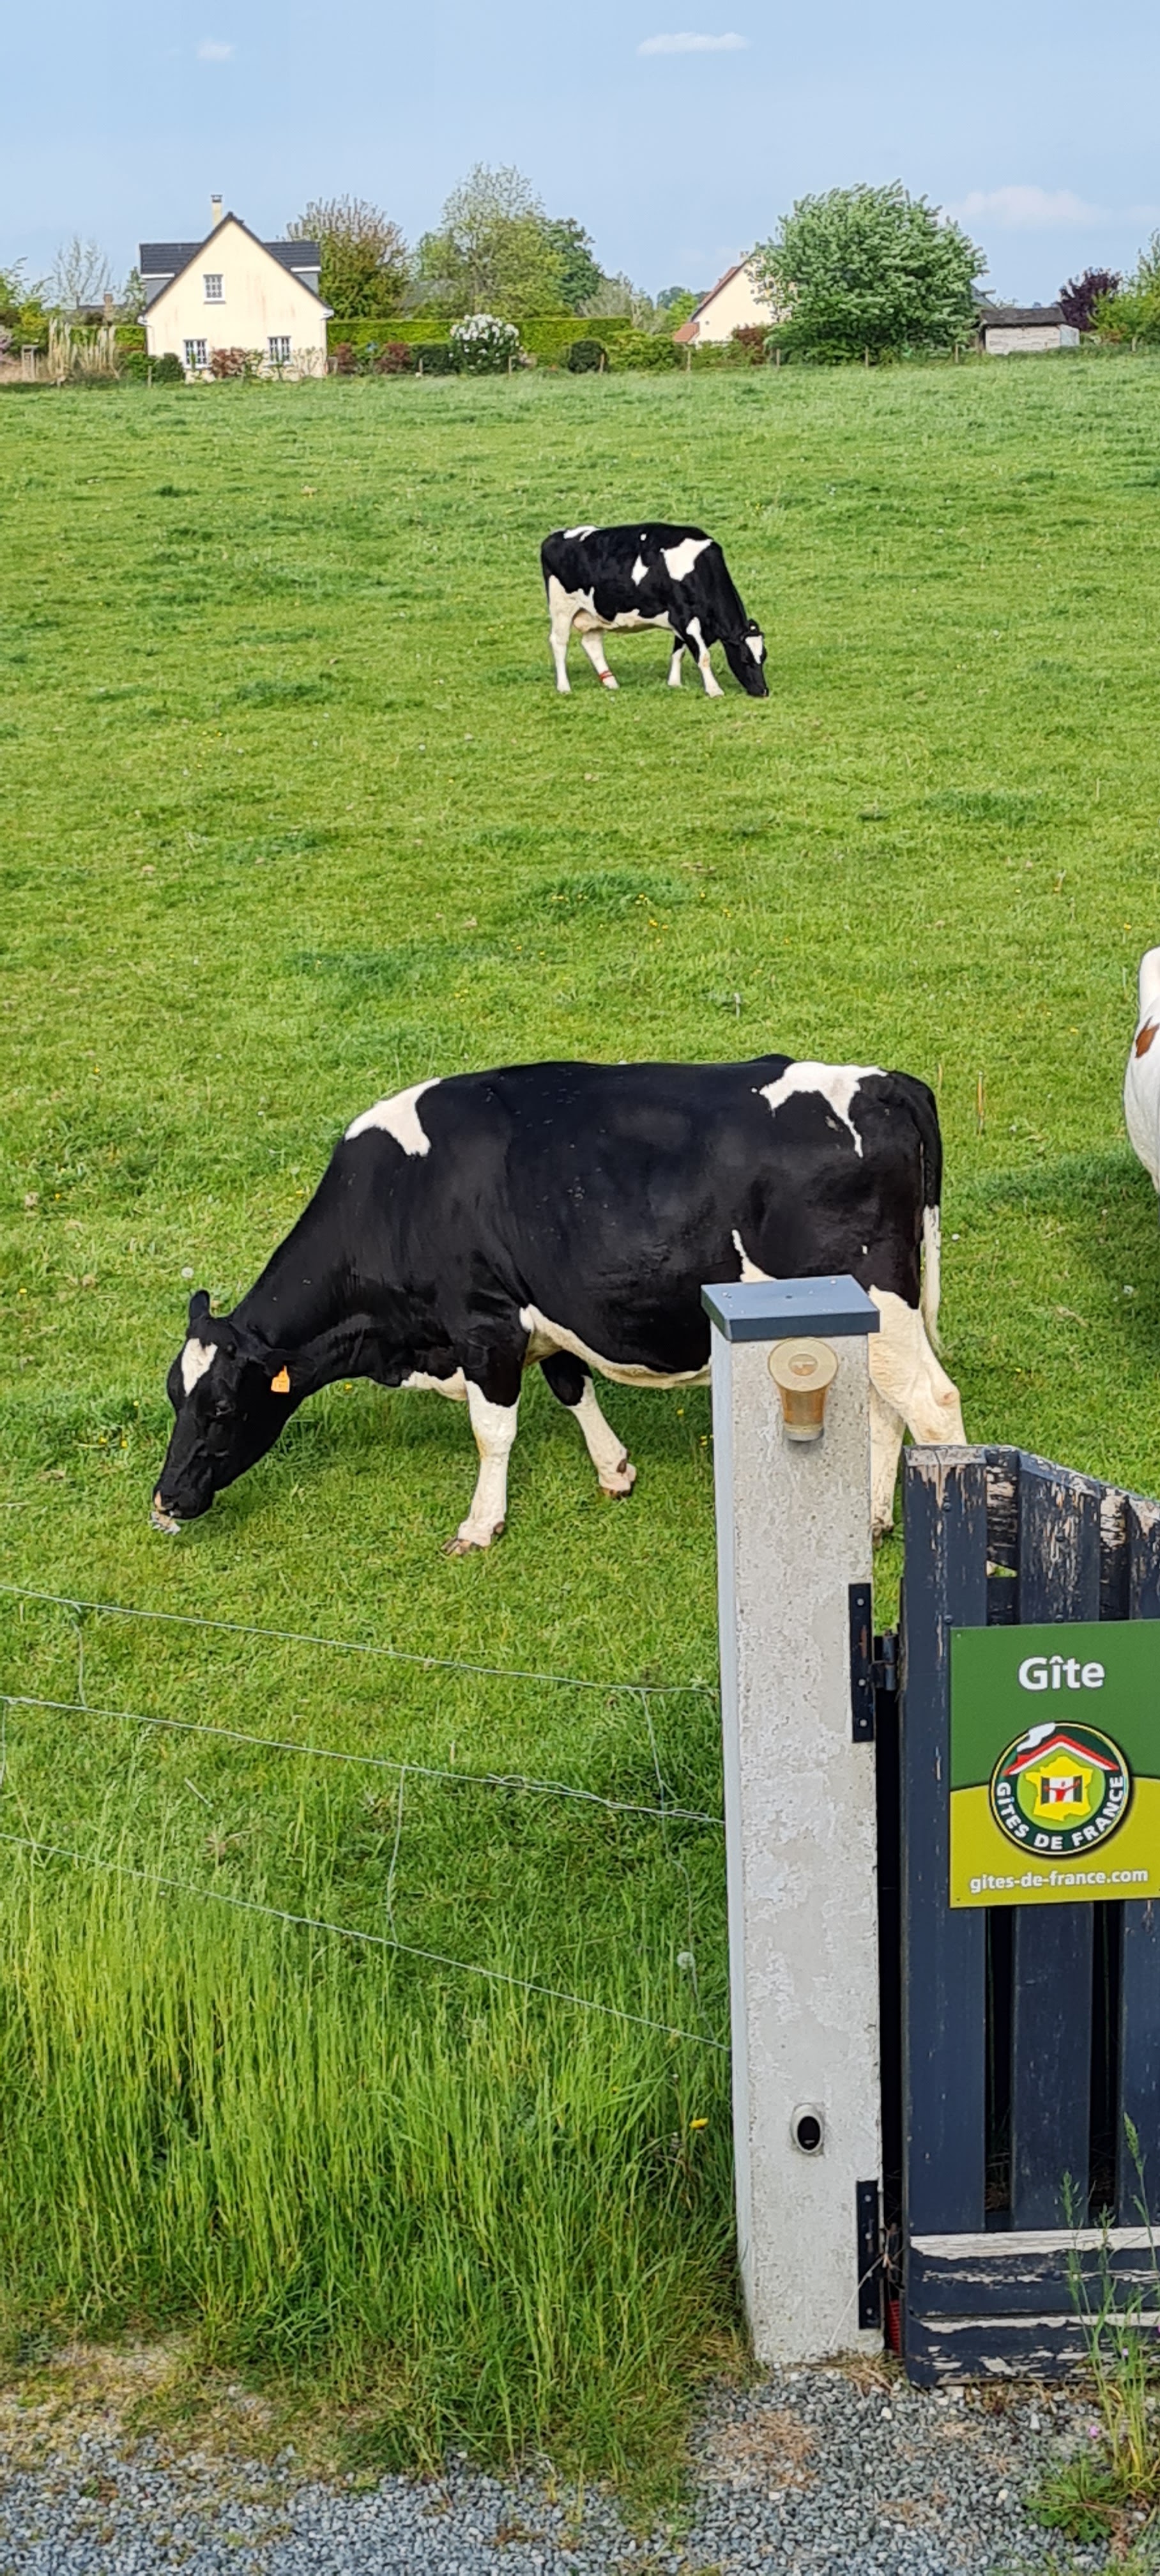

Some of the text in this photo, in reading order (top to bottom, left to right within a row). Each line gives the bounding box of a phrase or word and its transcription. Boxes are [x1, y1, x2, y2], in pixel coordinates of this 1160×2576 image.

[1018, 1655, 1106, 1690] Gîte
[1033, 1832, 1064, 1850] DE
[1071, 1775, 1124, 1847] FRANCE
[970, 1869, 1149, 1894] gites-de-france.com
